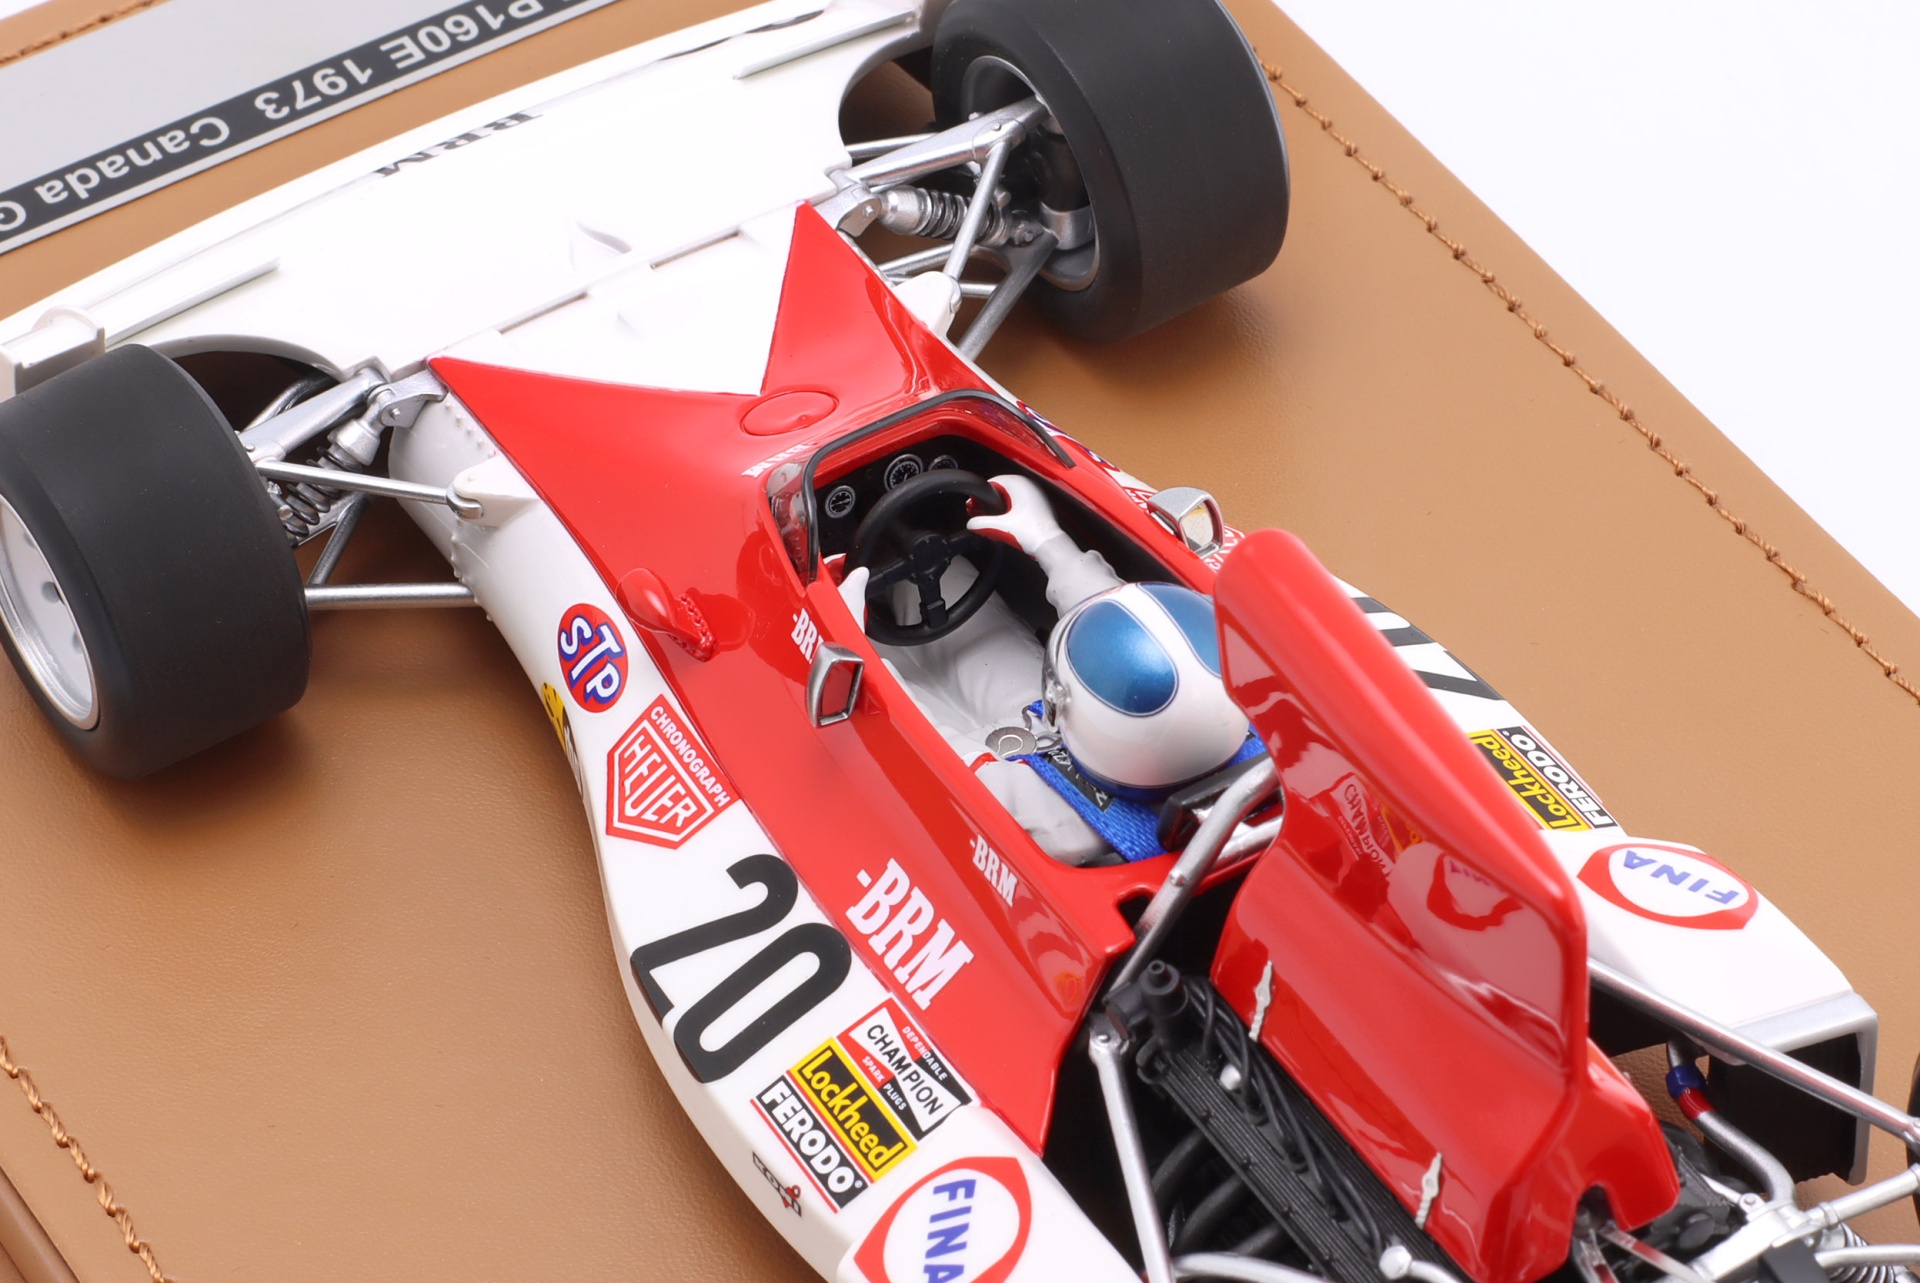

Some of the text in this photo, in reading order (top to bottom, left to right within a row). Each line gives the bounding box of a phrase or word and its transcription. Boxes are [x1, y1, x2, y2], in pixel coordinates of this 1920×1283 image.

[379, 0, 544, 70] P160E
[254, 58, 373, 120] 1973
[34, 117, 230, 204] Canada
[373, 112, 544, 178] BRM
[560, 615, 621, 702] STP
[623, 734, 698, 828] HEUER
[650, 706, 731, 808] CHRONOGRAPH
[1471, 736, 1577, 828] Lockheed
[1623, 850, 1739, 905] FINA
[630, 853, 852, 1083] 20
[862, 1056, 907, 1110] SPARK PLUGS
[867, 1024, 944, 1115] CHAMPION
[901, 1025, 948, 1081] DEPENDABLE
[801, 1049, 905, 1168] Lockheed
